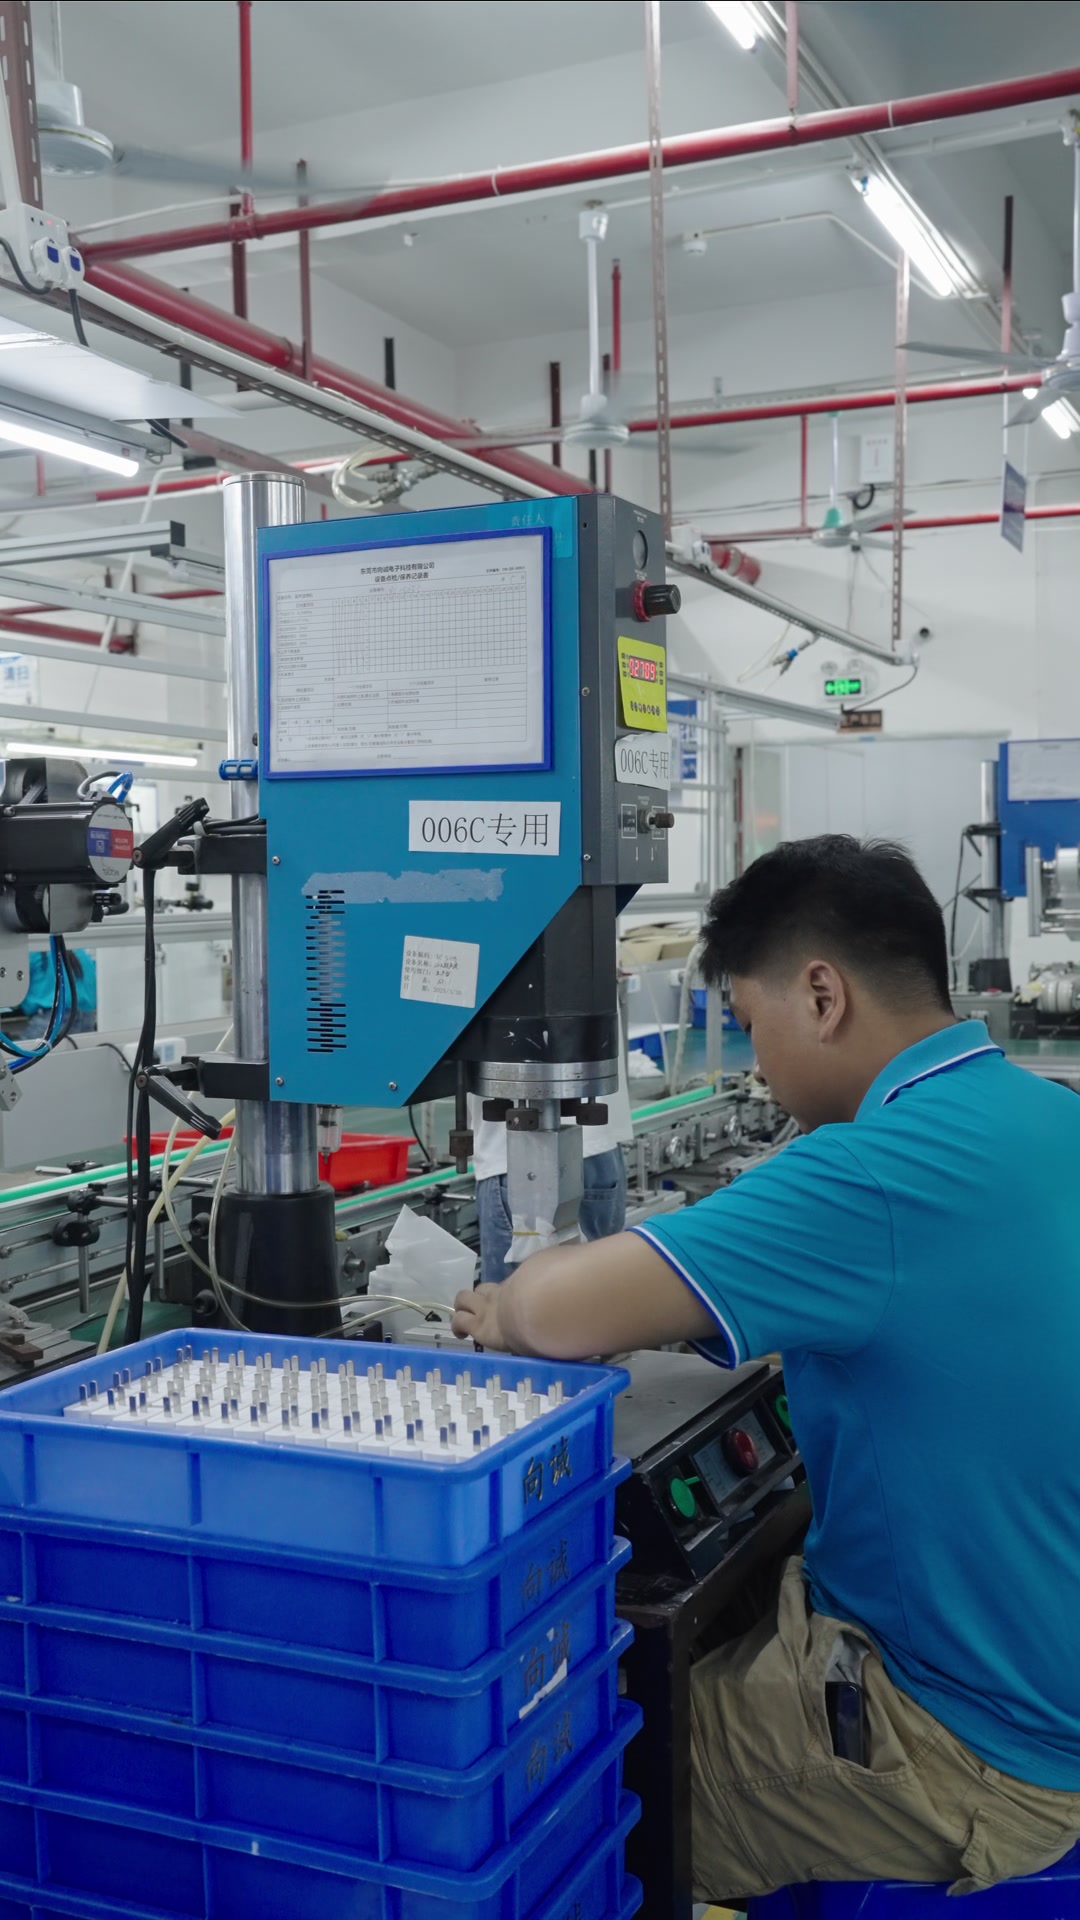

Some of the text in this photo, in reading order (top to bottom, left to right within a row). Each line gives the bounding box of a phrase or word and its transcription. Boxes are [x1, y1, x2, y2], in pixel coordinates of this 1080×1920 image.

[511, 512, 545, 528] 责任人
[620, 748, 669, 780] 006C专用
[421, 812, 549, 847] 006C专用
[523, 1435, 572, 1506] 向诚
